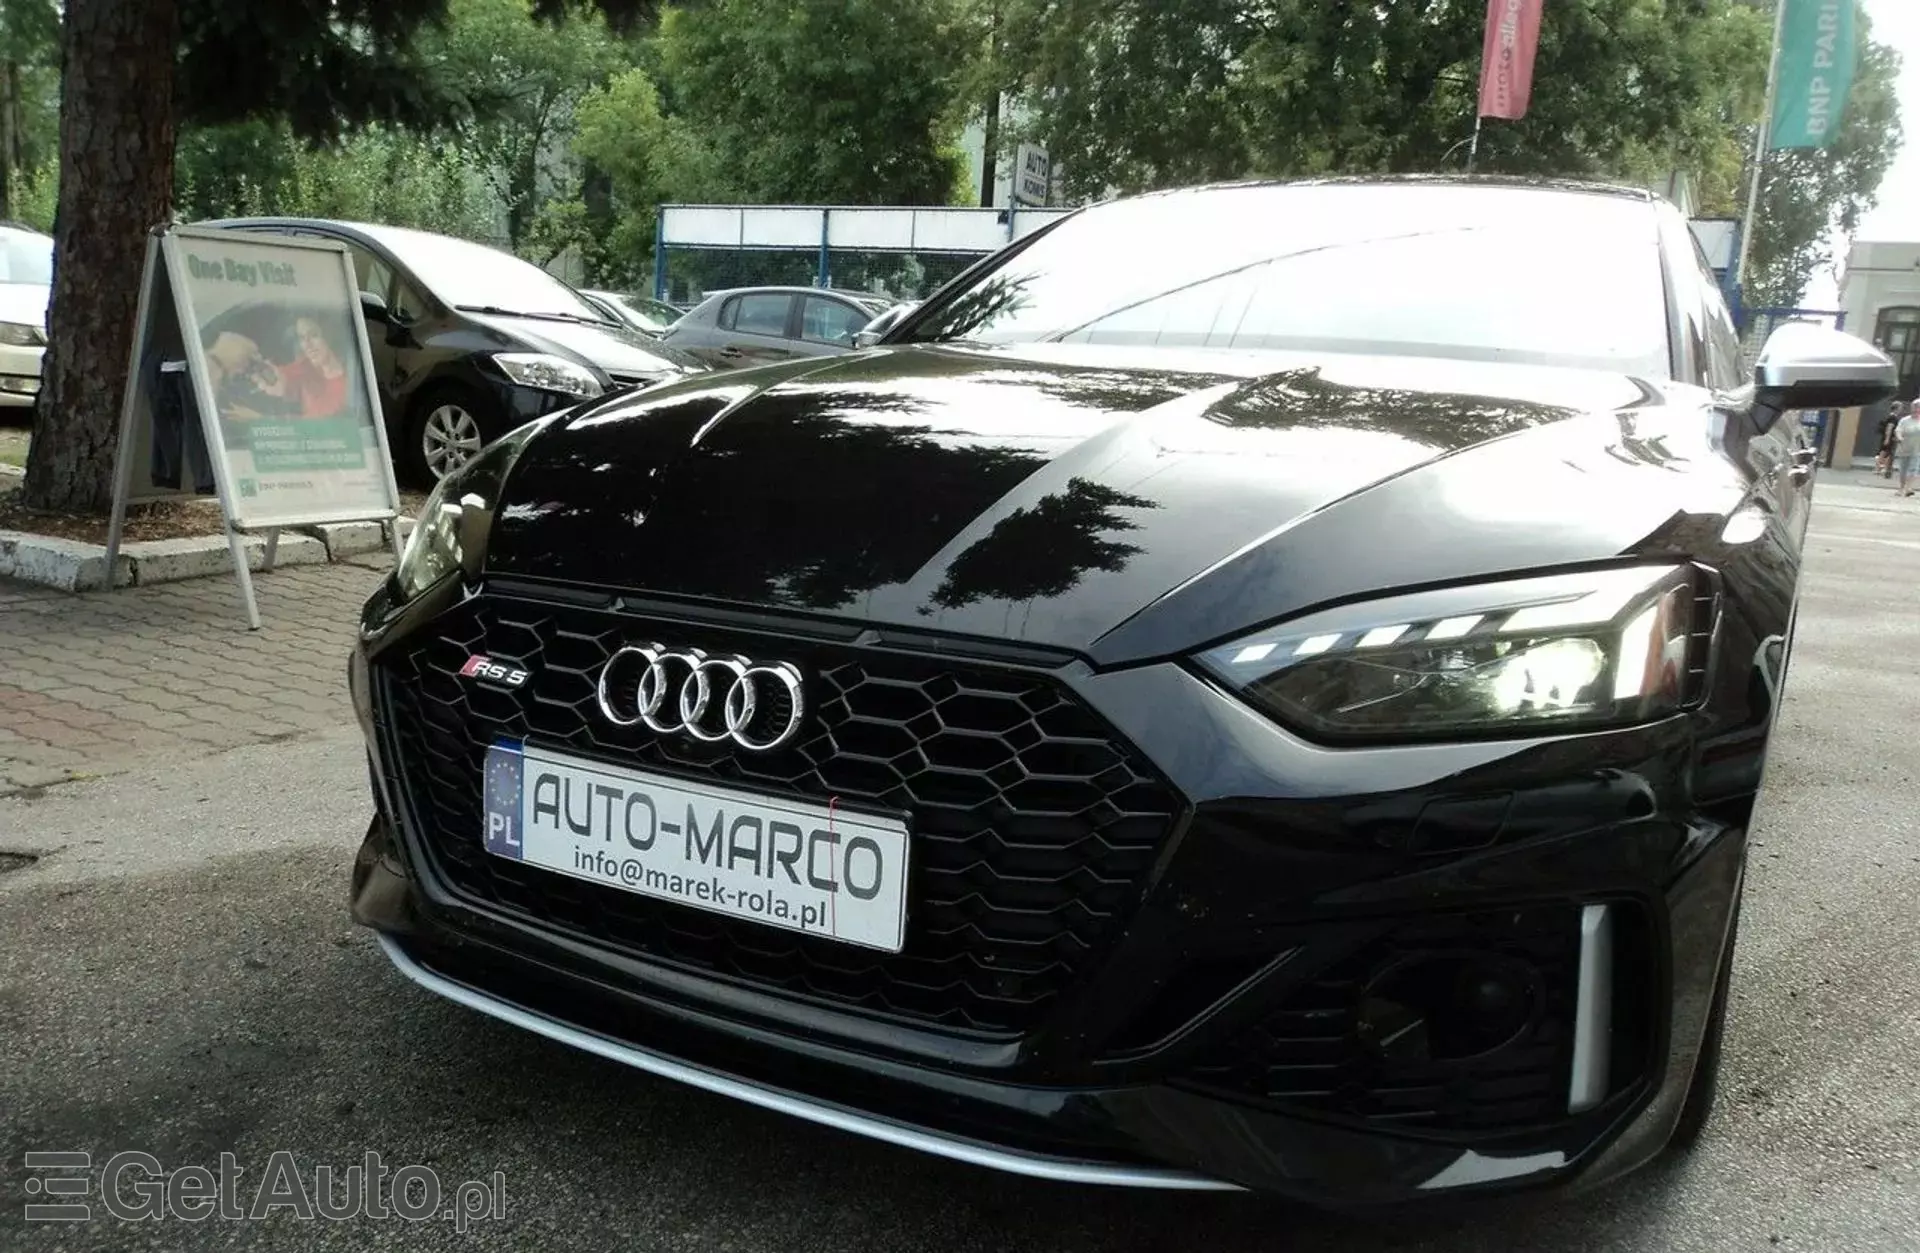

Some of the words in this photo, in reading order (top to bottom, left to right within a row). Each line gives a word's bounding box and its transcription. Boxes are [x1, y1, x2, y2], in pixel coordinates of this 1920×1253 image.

[1807, 75, 1831, 134] BNP
[1026, 151, 1047, 176] AUTO
[187, 253, 224, 279] One
[224, 257, 257, 287] Day
[257, 260, 297, 286] Visit
[488, 811, 521, 847] PL
[532, 772, 884, 901] AUTO-MARCO
[574, 845, 827, 928] info@marek-rola.pl
